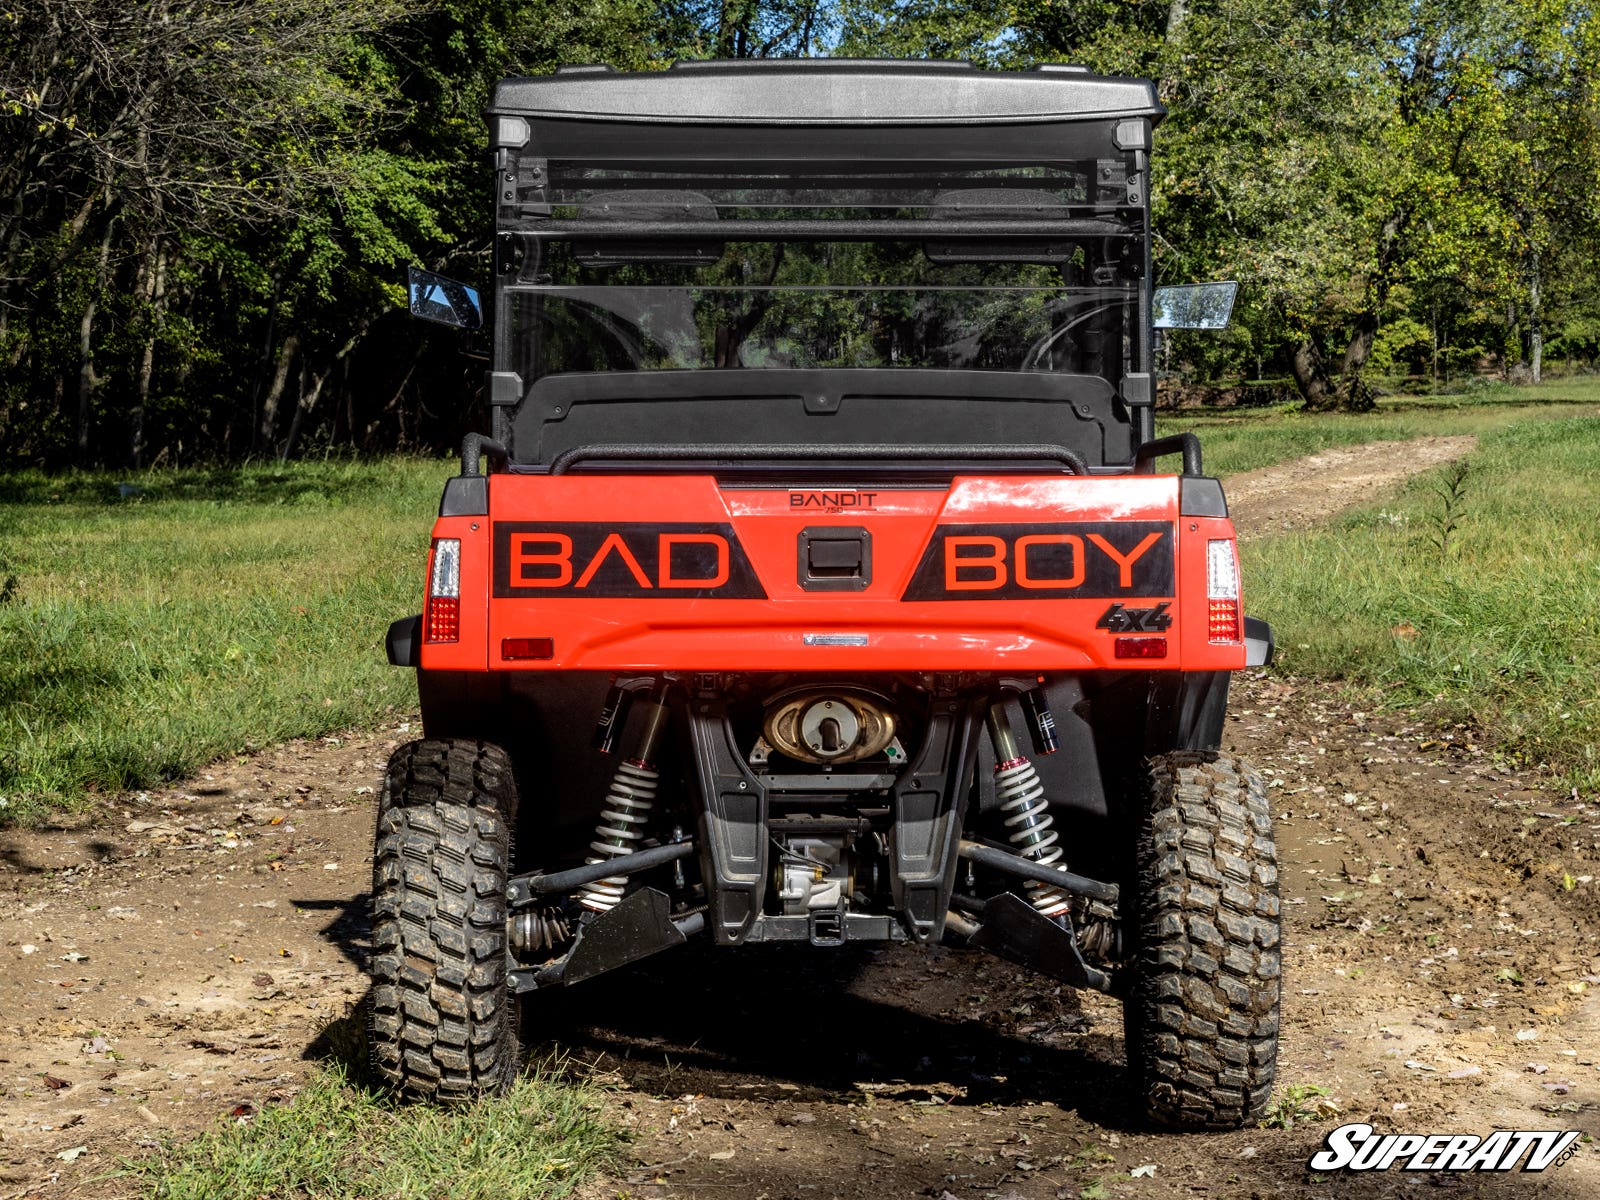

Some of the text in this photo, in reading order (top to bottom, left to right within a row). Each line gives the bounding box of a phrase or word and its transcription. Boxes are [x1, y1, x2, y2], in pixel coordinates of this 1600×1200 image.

[790, 493, 878, 507] BANDIT
[509, 532, 1164, 591] BAD BOY
[1096, 602, 1173, 633] 4x4
